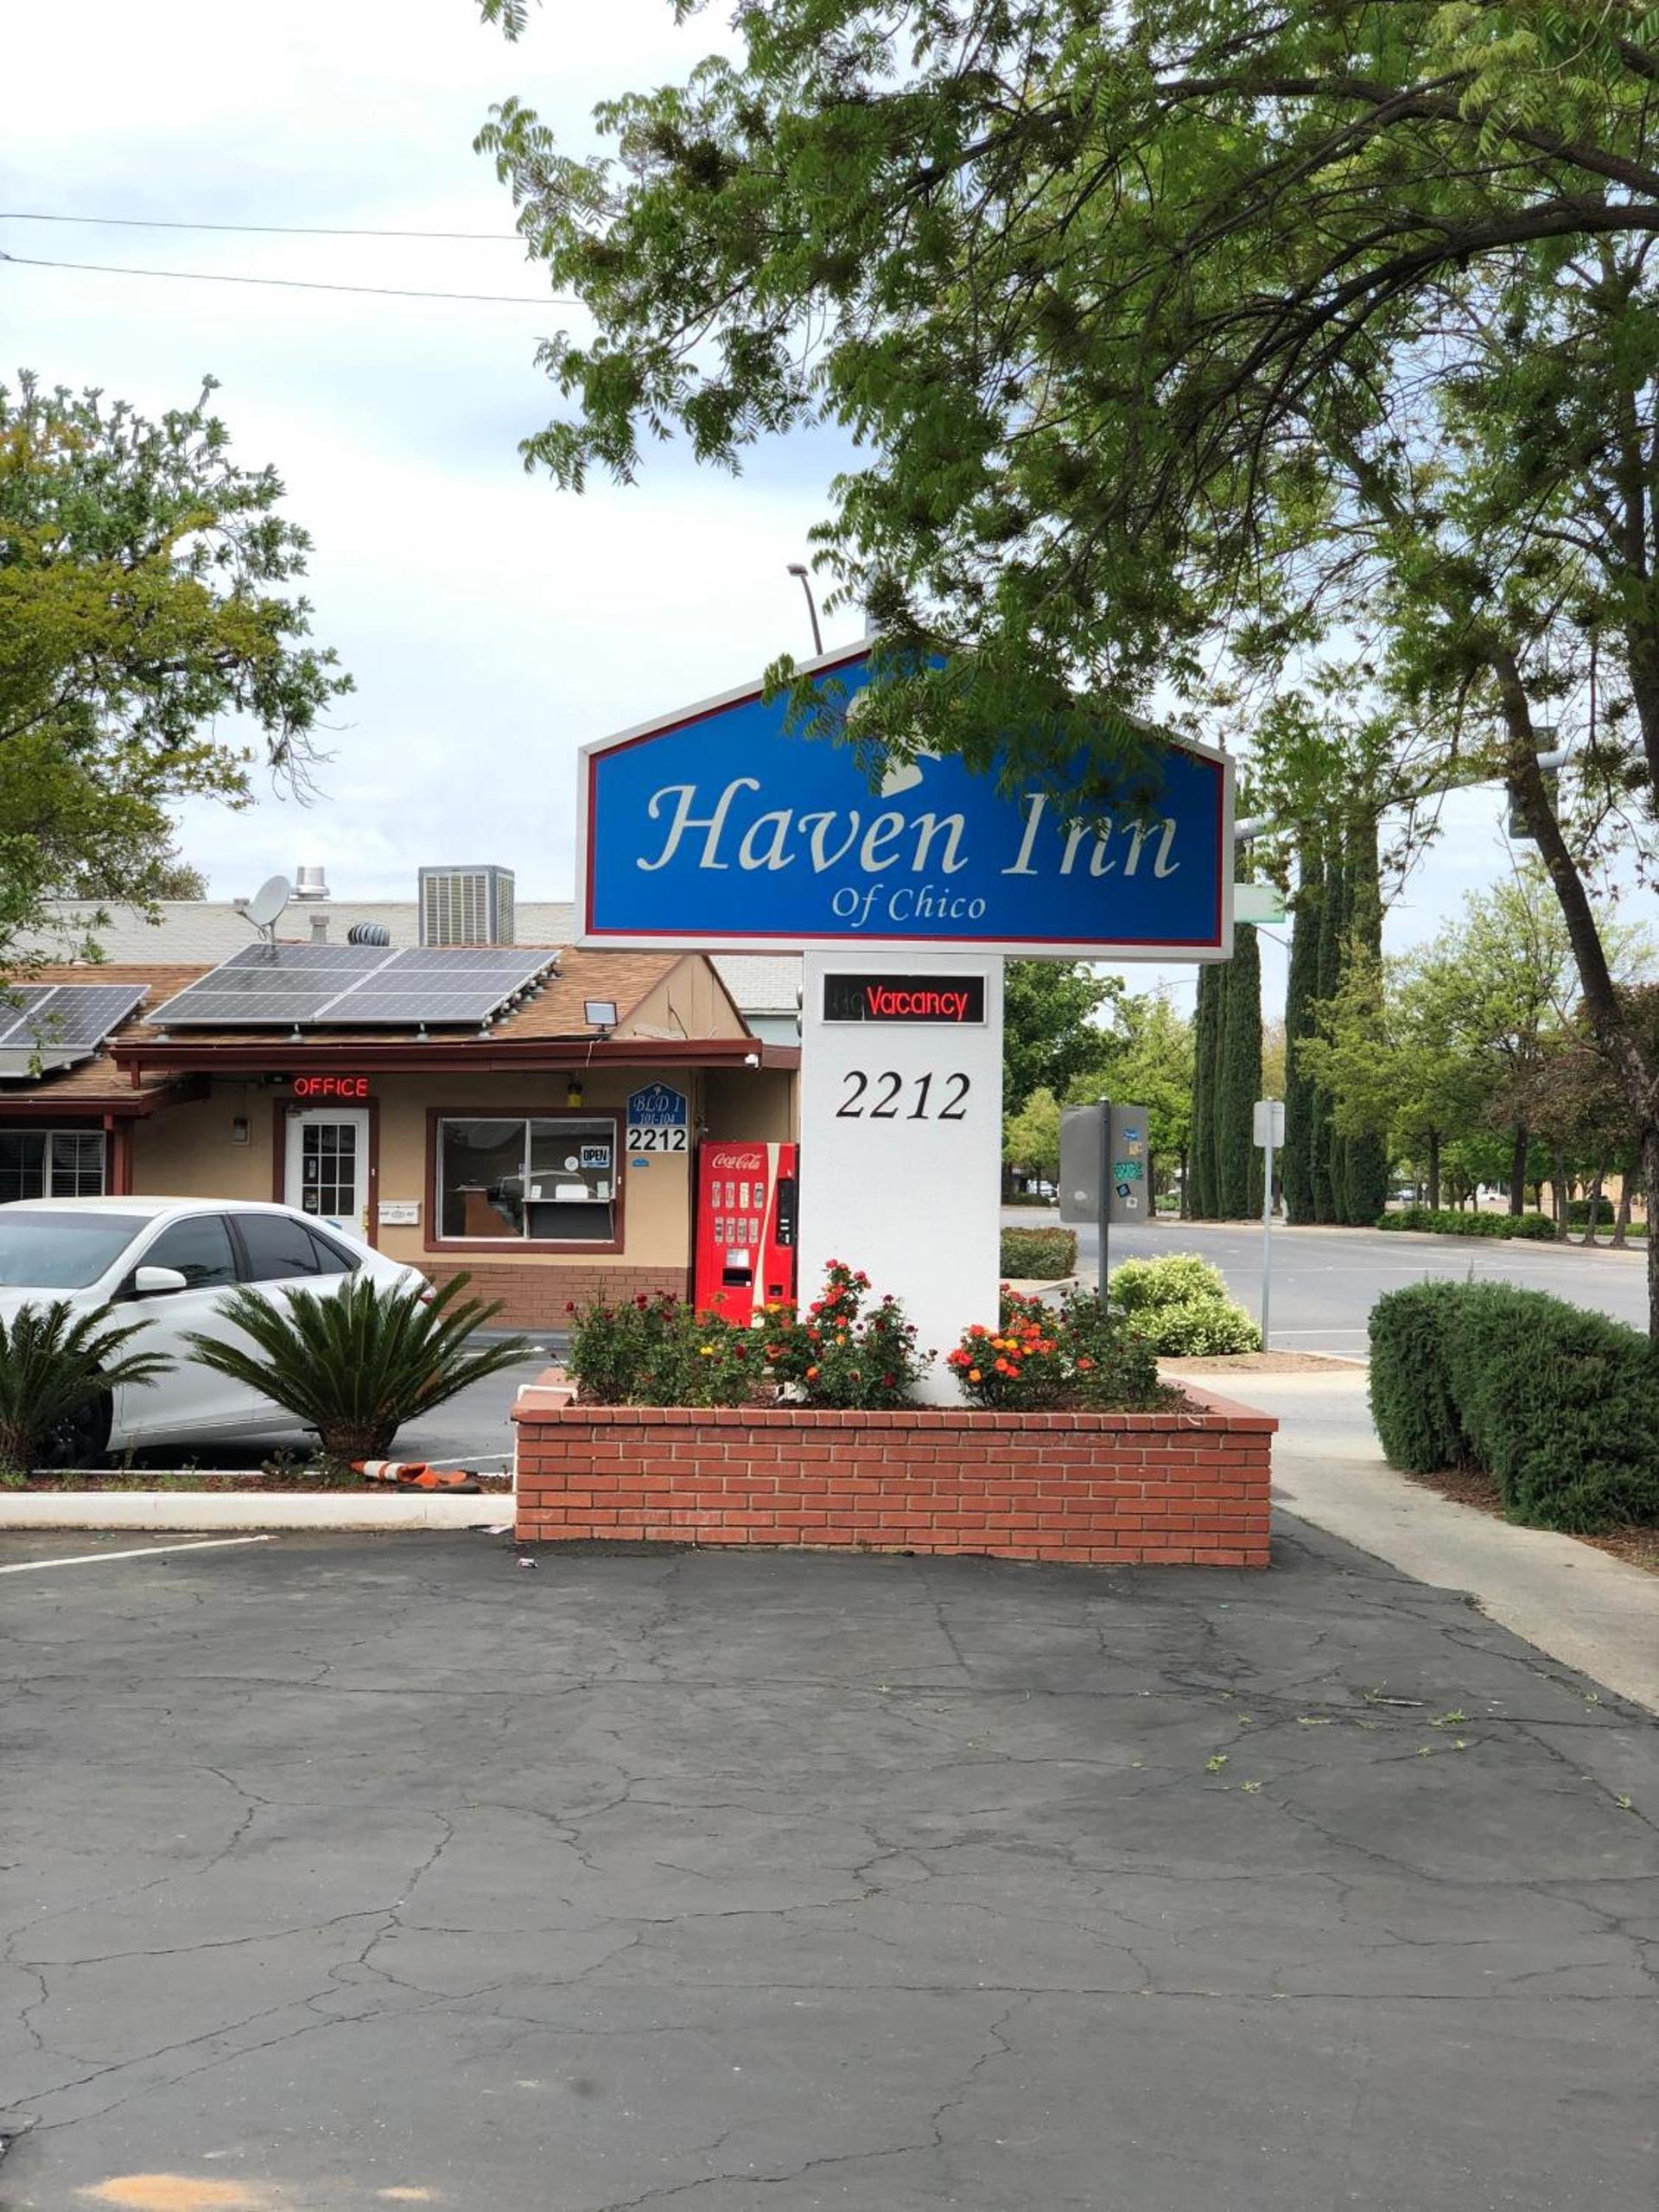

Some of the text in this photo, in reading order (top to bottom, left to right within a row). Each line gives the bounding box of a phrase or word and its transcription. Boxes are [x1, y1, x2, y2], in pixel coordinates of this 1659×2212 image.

[637, 778, 1180, 879] Haven Inn
[831, 884, 987, 928] Of Chico
[867, 985, 969, 1021] Vacancy
[295, 1078, 367, 1096] OFFICE
[836, 1071, 971, 1121] 2212
[633, 1095, 670, 1112] BLD
[628, 1128, 686, 1151] 2212
[583, 1148, 607, 1161] OPEN
[711, 1153, 763, 1170] CocaCola
